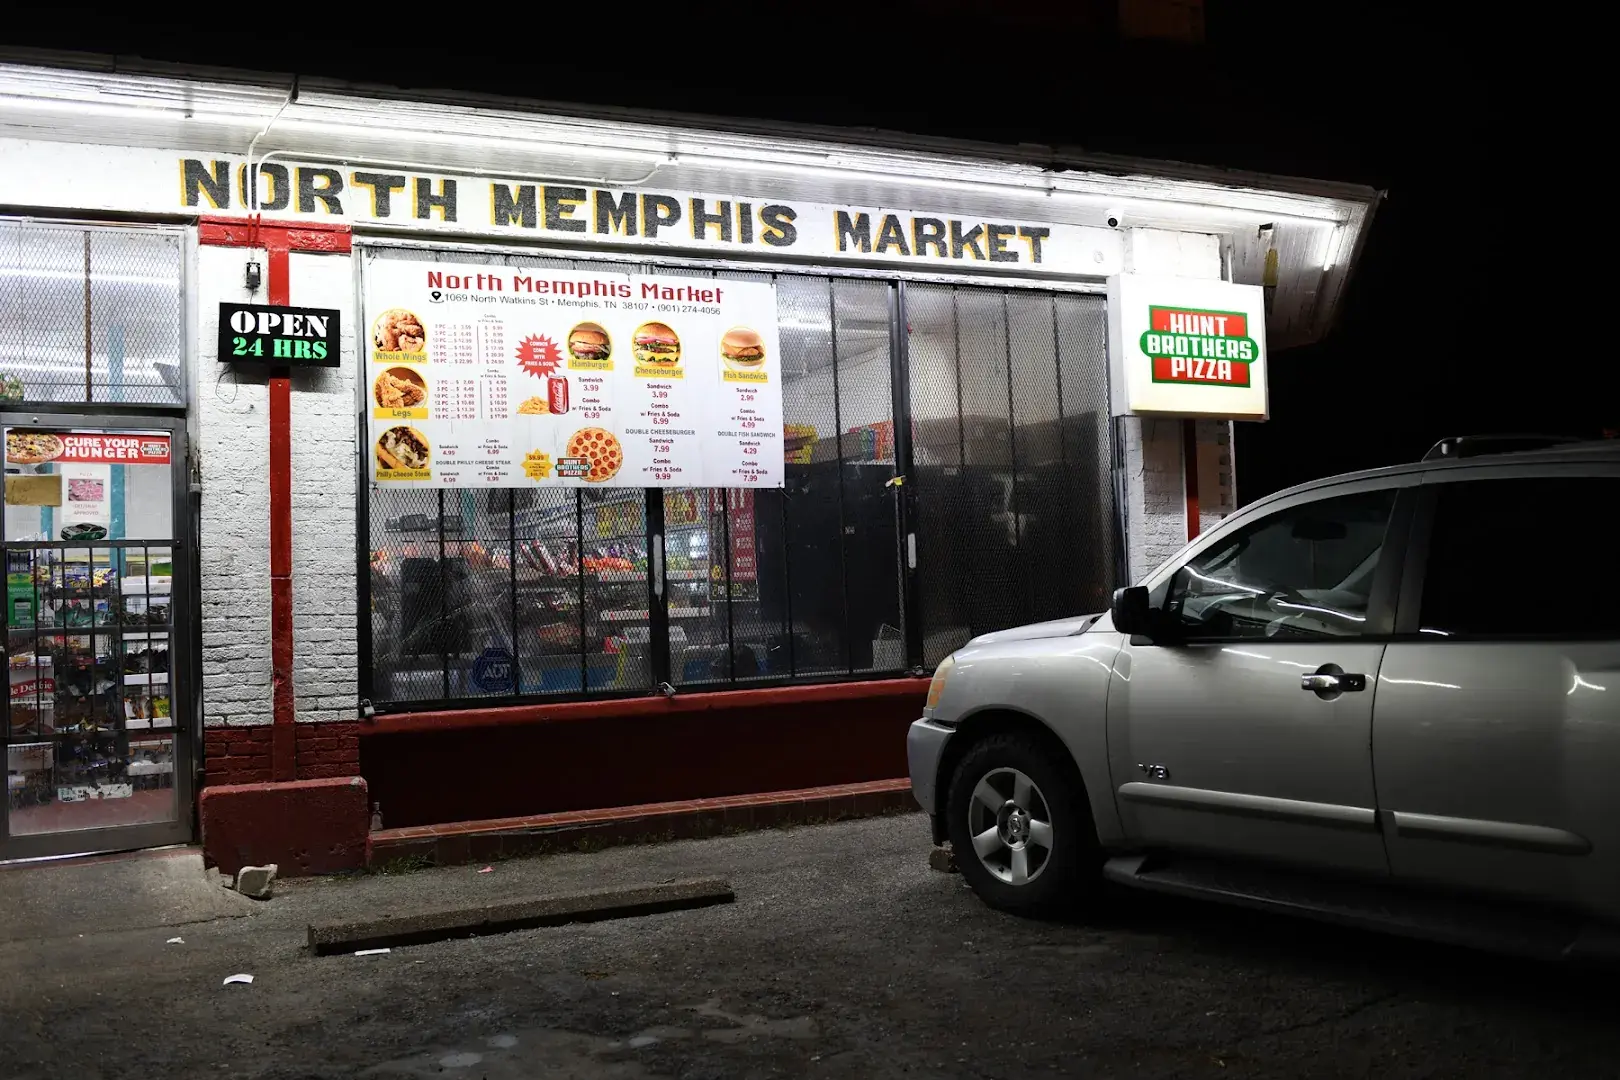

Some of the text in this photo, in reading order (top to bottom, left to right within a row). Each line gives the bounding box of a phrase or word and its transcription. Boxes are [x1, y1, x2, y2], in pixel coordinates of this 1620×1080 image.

[179, 159, 1050, 263] NORTH MEMPHIS MARKET
[427, 271, 724, 303] North Memphis Market
[445, 293, 468, 302] 1069
[471, 294, 497, 303] North
[500, 296, 536, 305] Watkins
[604, 301, 617, 309] TN
[622, 302, 648, 310] 38107
[657, 303, 680, 313] (901)
[682, 305, 720, 315] 274-4056
[230, 310, 329, 338] OPEN
[1170, 313, 1228, 336] HUNT
[232, 337, 328, 359] 24 HRS
[376, 352, 426, 363] Whole Wings
[1146, 334, 1252, 360] BROTHERS
[572, 360, 609, 369] Hamburger
[635, 367, 683, 376] Cheeseburger
[1171, 356, 1232, 380] PIZZA
[392, 409, 411, 418] Legs
[64, 437, 139, 448] CURE YOUR
[65, 447, 139, 459] HUNGER
[482, 663, 510, 678] ADT
